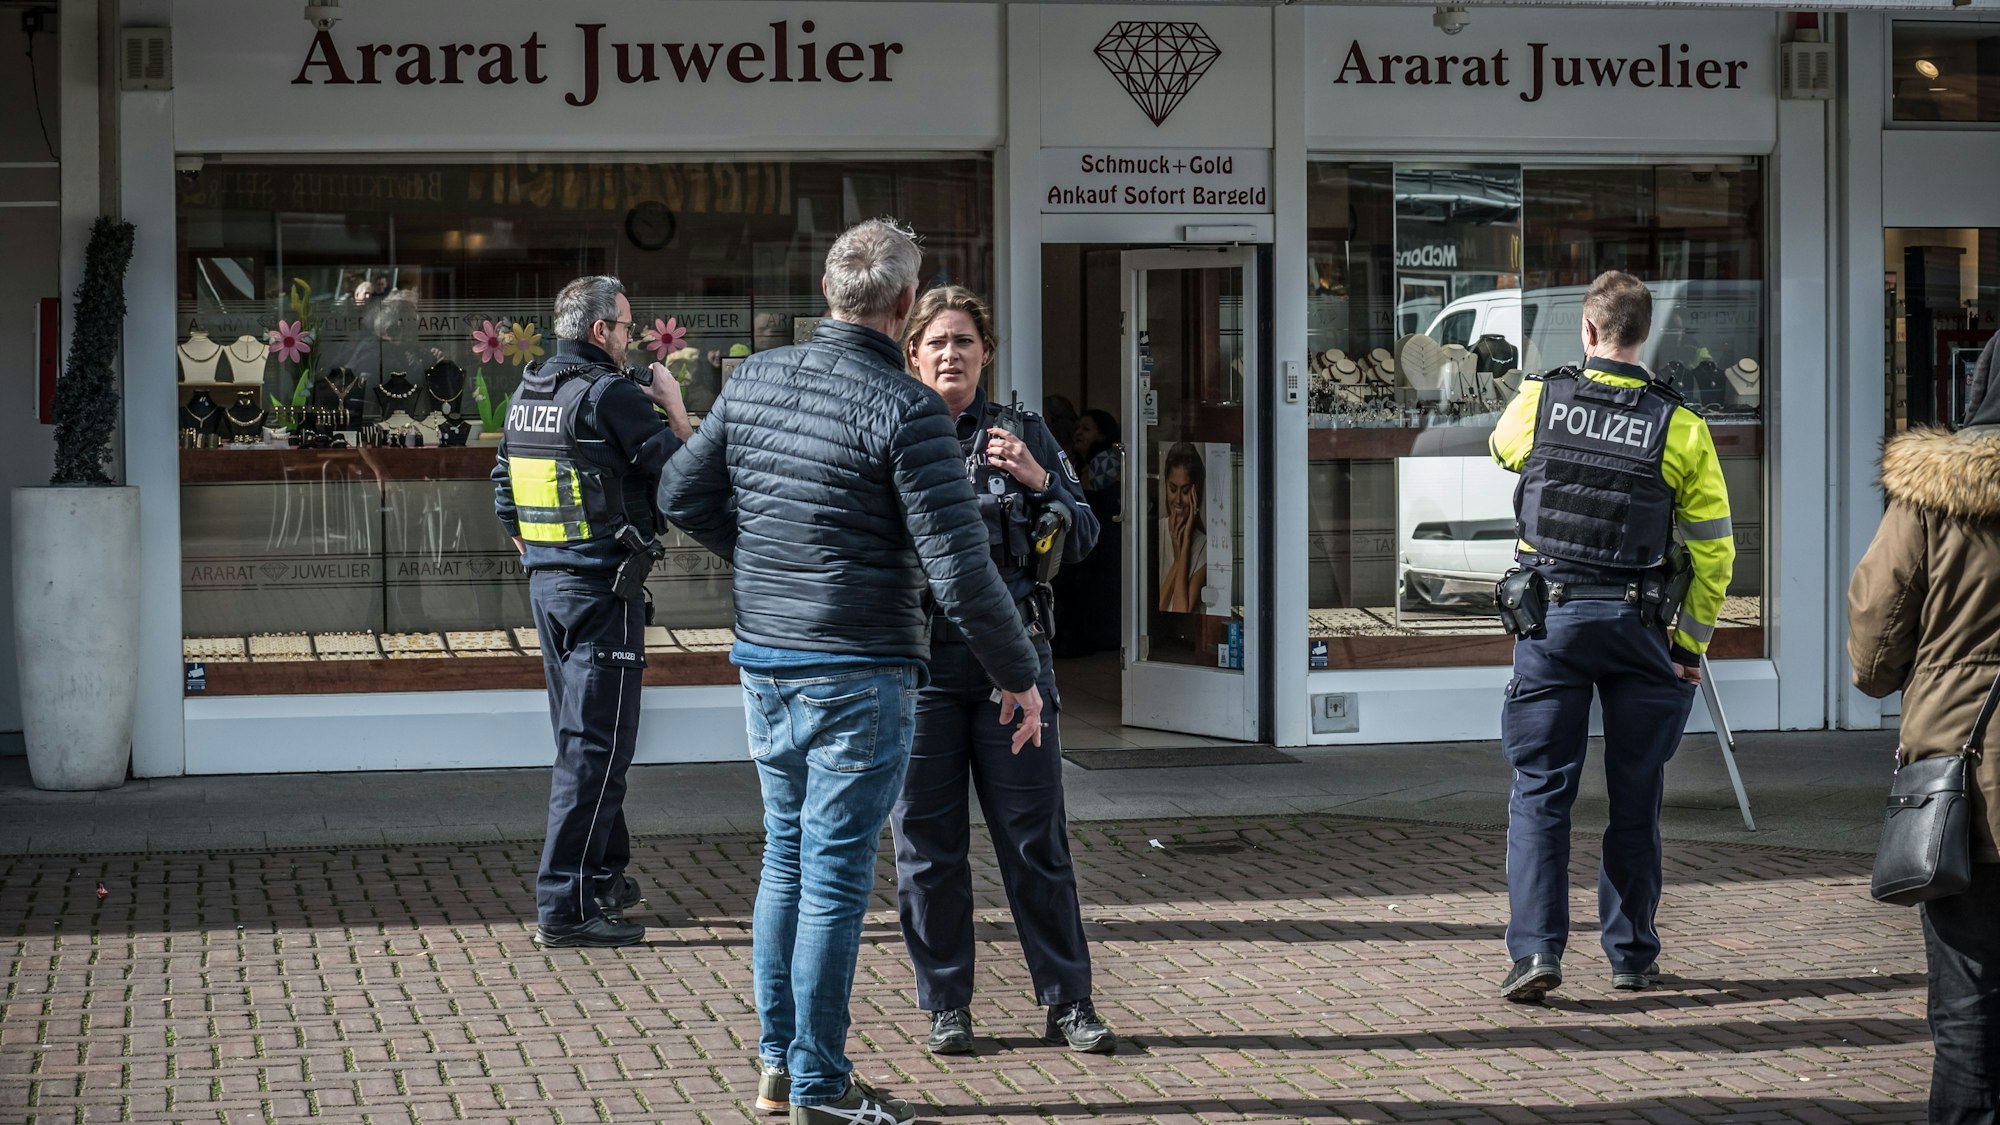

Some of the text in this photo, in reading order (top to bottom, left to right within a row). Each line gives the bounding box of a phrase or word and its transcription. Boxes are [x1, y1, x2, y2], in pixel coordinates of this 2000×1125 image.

[290, 20, 904, 107] Ararat Juwelier
[1333, 39, 1749, 103] Ararat Juwelier
[1081, 153, 1234, 175] Schmuck+Gold
[1047, 185, 1266, 206] Ankauf Sofort Bargeld
[508, 403, 564, 434] POLIZEI
[1548, 401, 1653, 449] POLIZEI
[191, 563, 371, 581] ARARAT JUWELIER
[398, 561, 462, 576] ARARAT
[611, 652, 636, 661] POLIZEI
